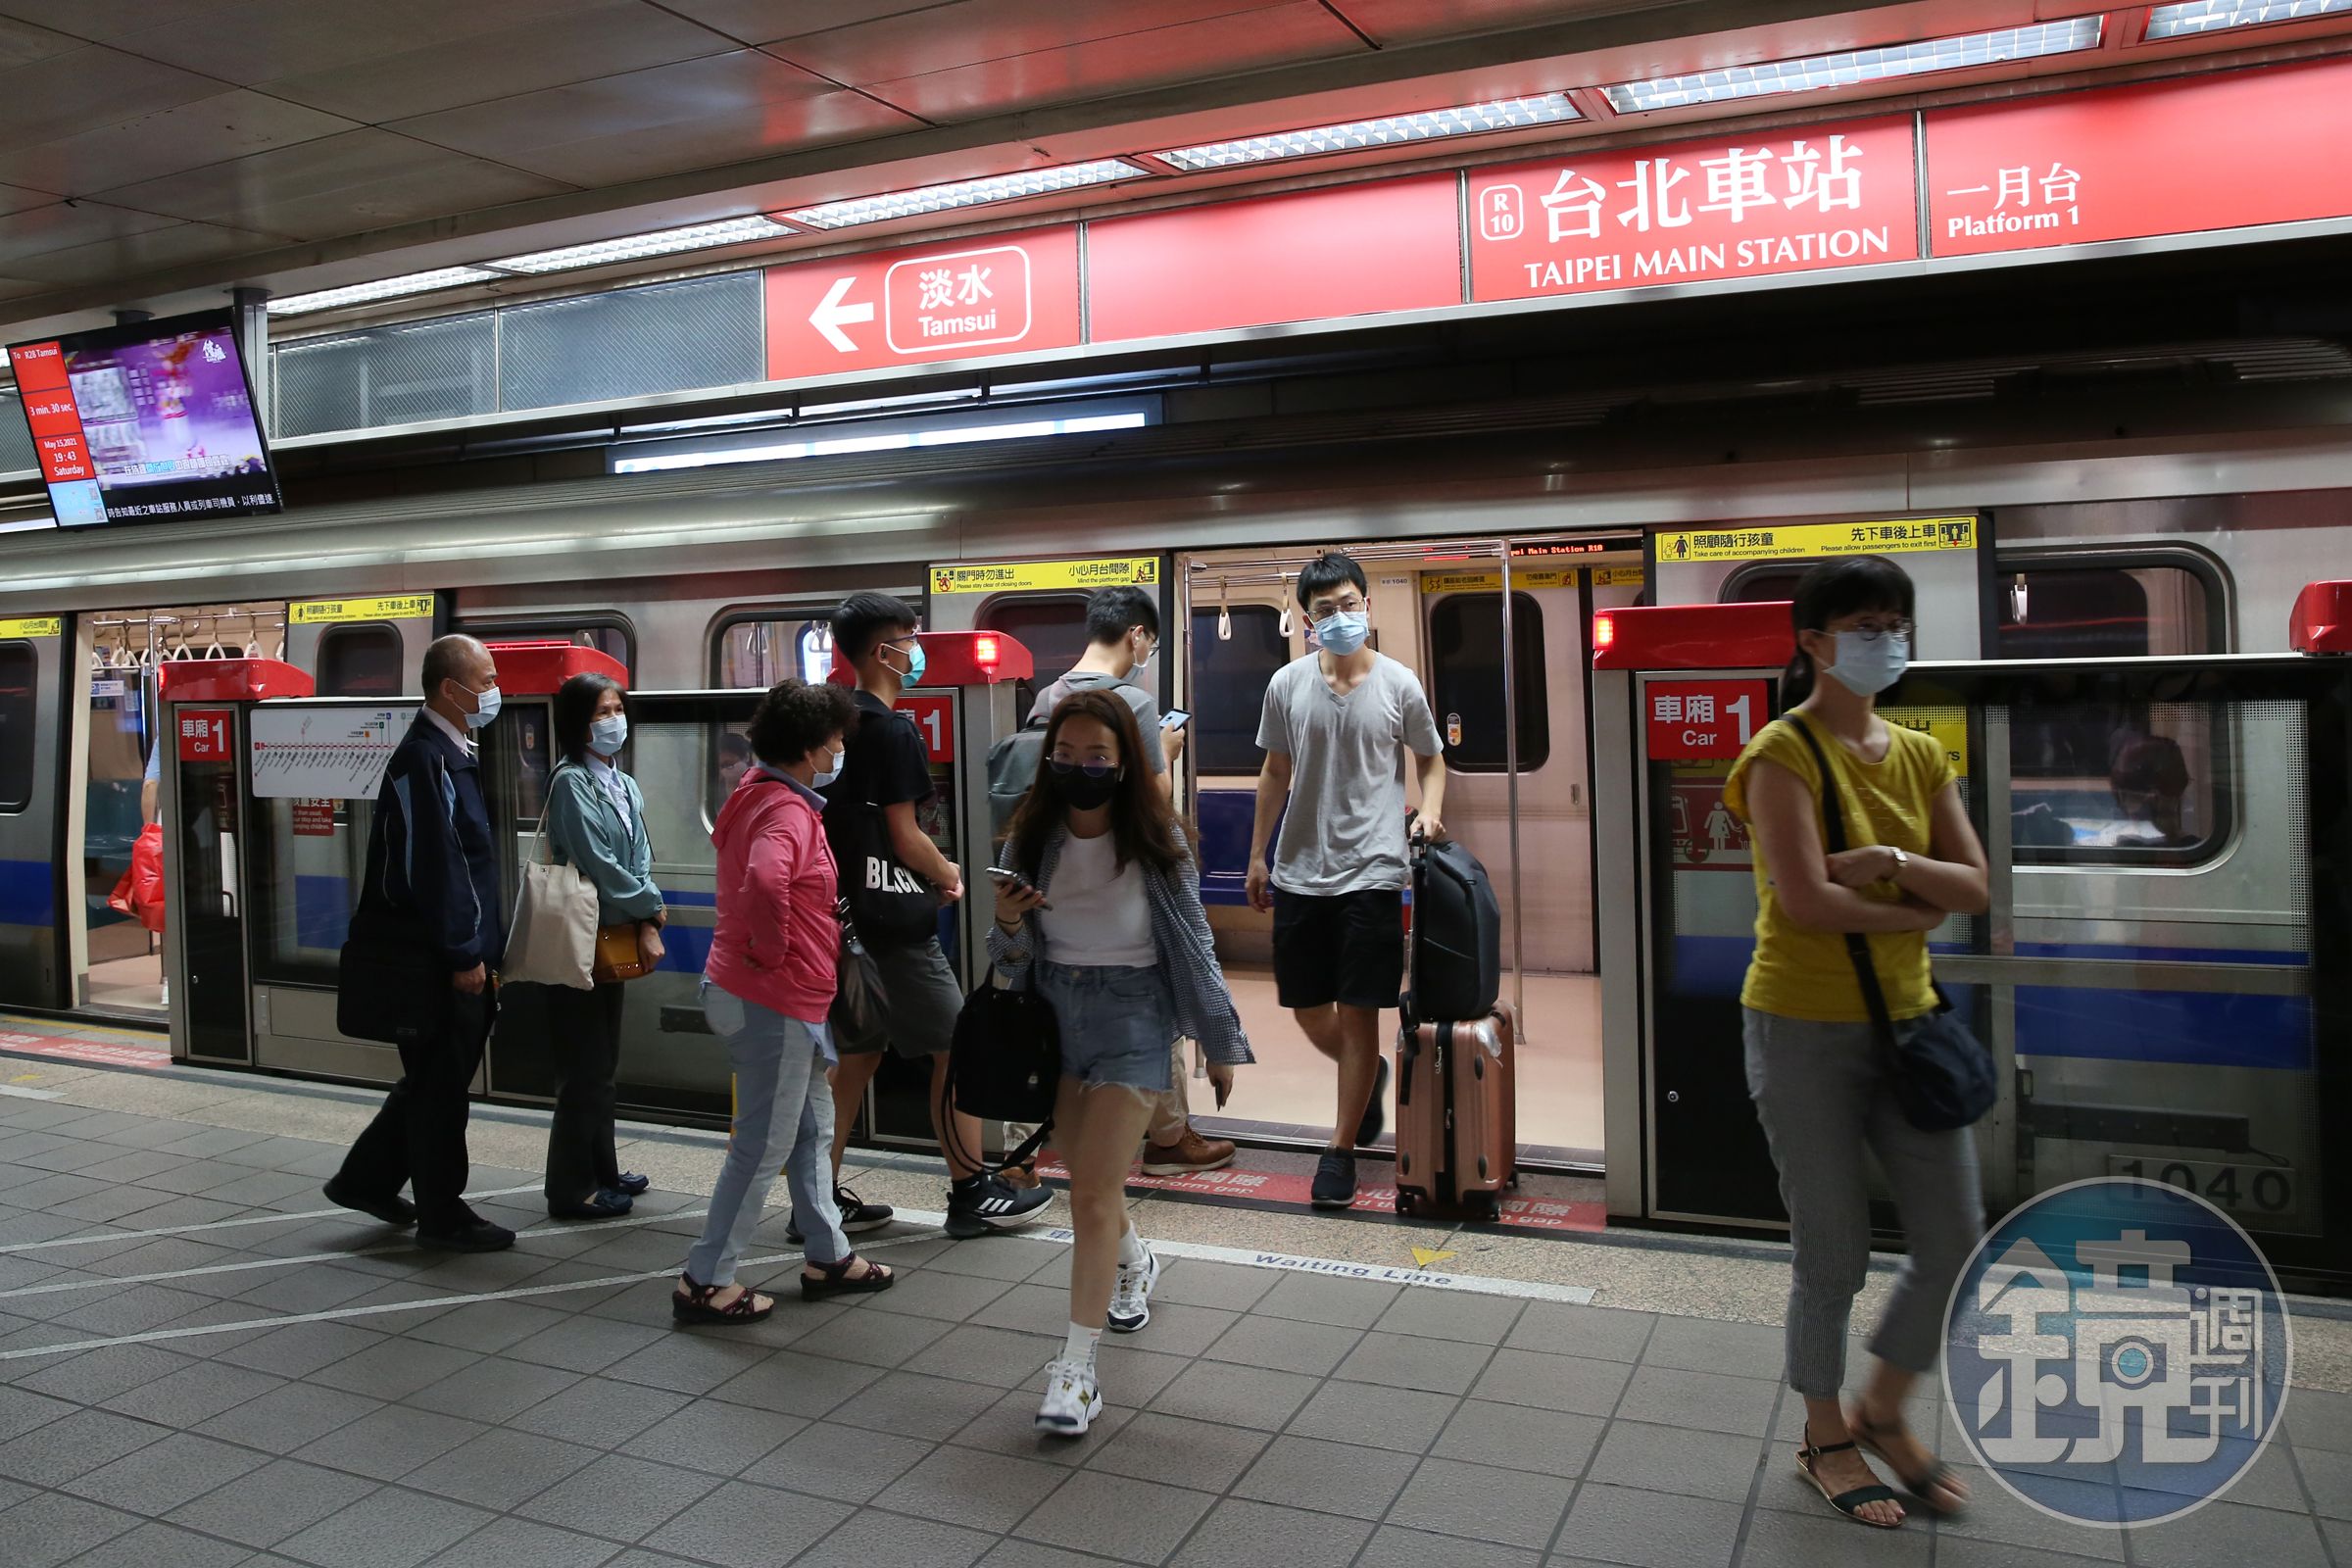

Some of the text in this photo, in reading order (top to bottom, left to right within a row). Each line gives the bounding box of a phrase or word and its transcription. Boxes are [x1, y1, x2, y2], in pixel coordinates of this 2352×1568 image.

[1540, 134, 1864, 243] 台北車站
[1946, 162, 2082, 210] 一月台
[1494, 193, 1509, 212] R
[1491, 214, 1514, 233] 10
[1948, 205, 2079, 237] Platform 1
[1524, 225, 1888, 288] TAIPEI MAIN STATION
[918, 264, 994, 310] 淡水
[917, 308, 997, 337] Tamsui
[29, 407, 35, 416] 3
[50, 403, 59, 413] 30
[54, 465, 84, 476] Saturday
[1693, 532, 1774, 549] 照顧隨行孩童
[1851, 524, 1936, 541] 先下車後上車
[1510, 548, 1524, 557] pei
[956, 568, 1014, 582] 關門時勿進出
[1068, 563, 1130, 576] 小心月台間隙
[1653, 695, 1715, 724] 車廂
[1726, 695, 1751, 745] 1
[181, 719, 209, 739] 車廂
[212, 719, 224, 753] 1
[923, 709, 941, 751] 1
[1682, 730, 1717, 746] Car
[194, 742, 210, 753] Car
[2123, 1159, 2291, 1212] 1040
[1255, 1253, 1451, 1286] Waiting Line
